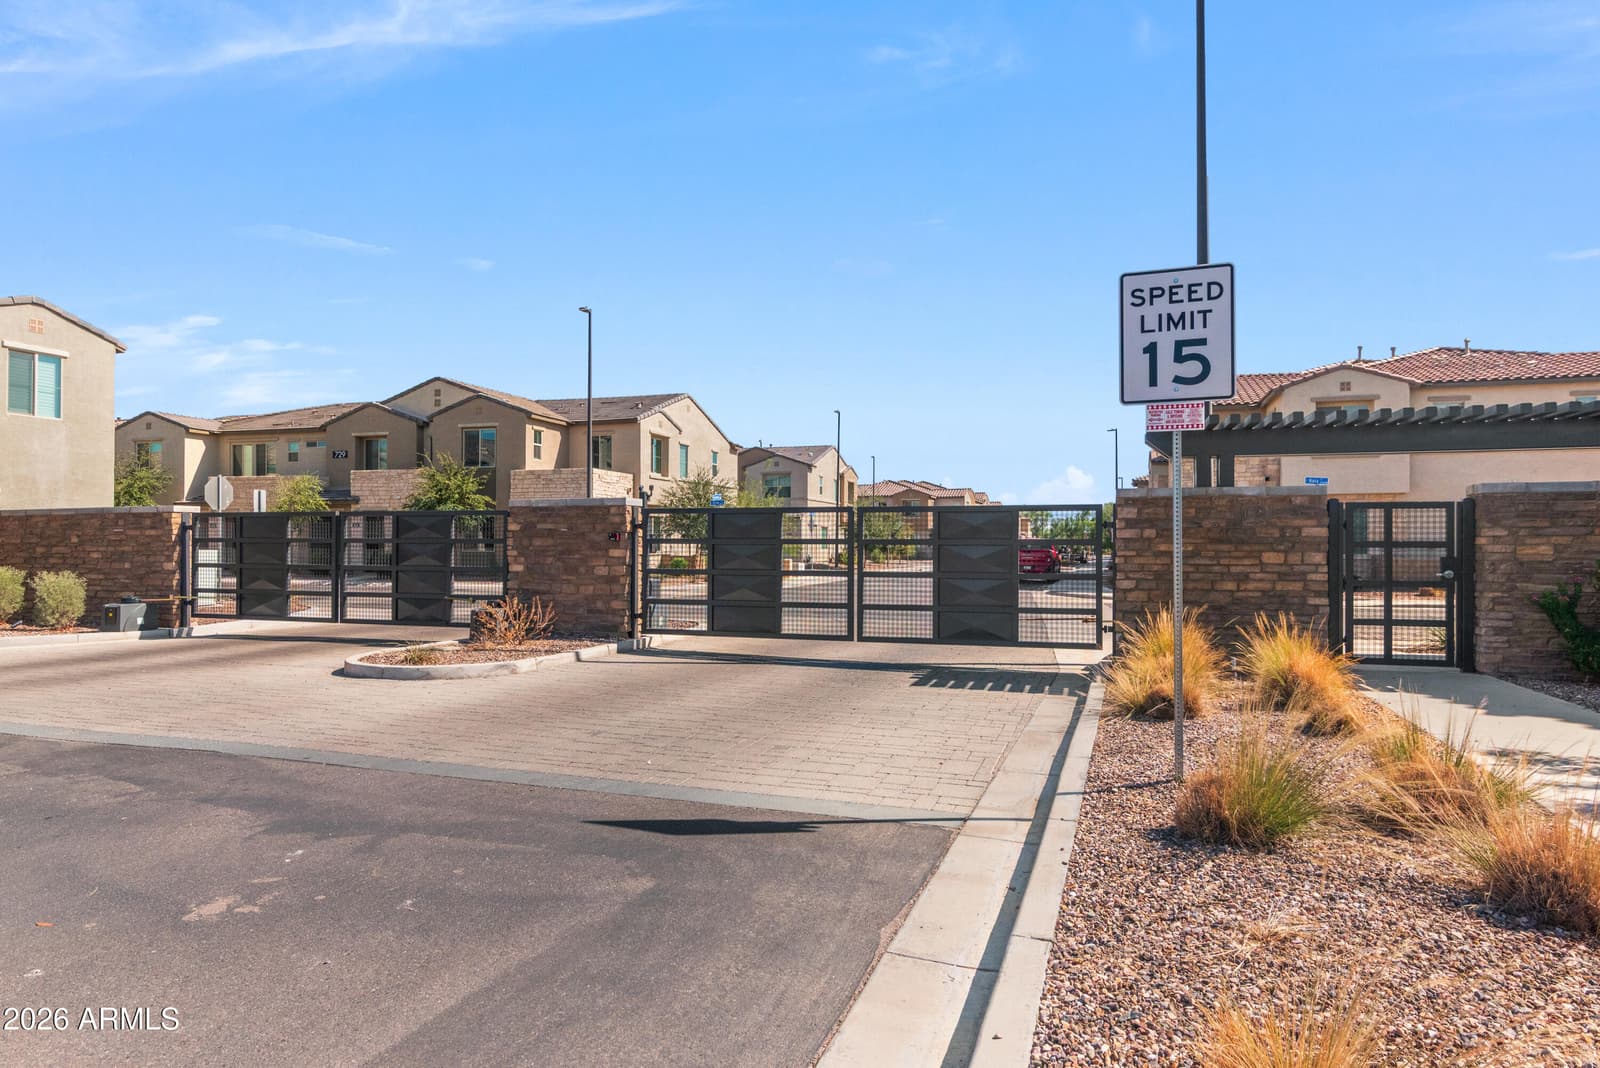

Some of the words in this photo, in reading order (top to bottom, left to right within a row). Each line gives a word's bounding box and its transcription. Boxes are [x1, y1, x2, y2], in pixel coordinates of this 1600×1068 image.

[1130, 281, 1224, 308] SPEED
[1140, 309, 1213, 334] LIMIT
[1142, 338, 1212, 388] 15
